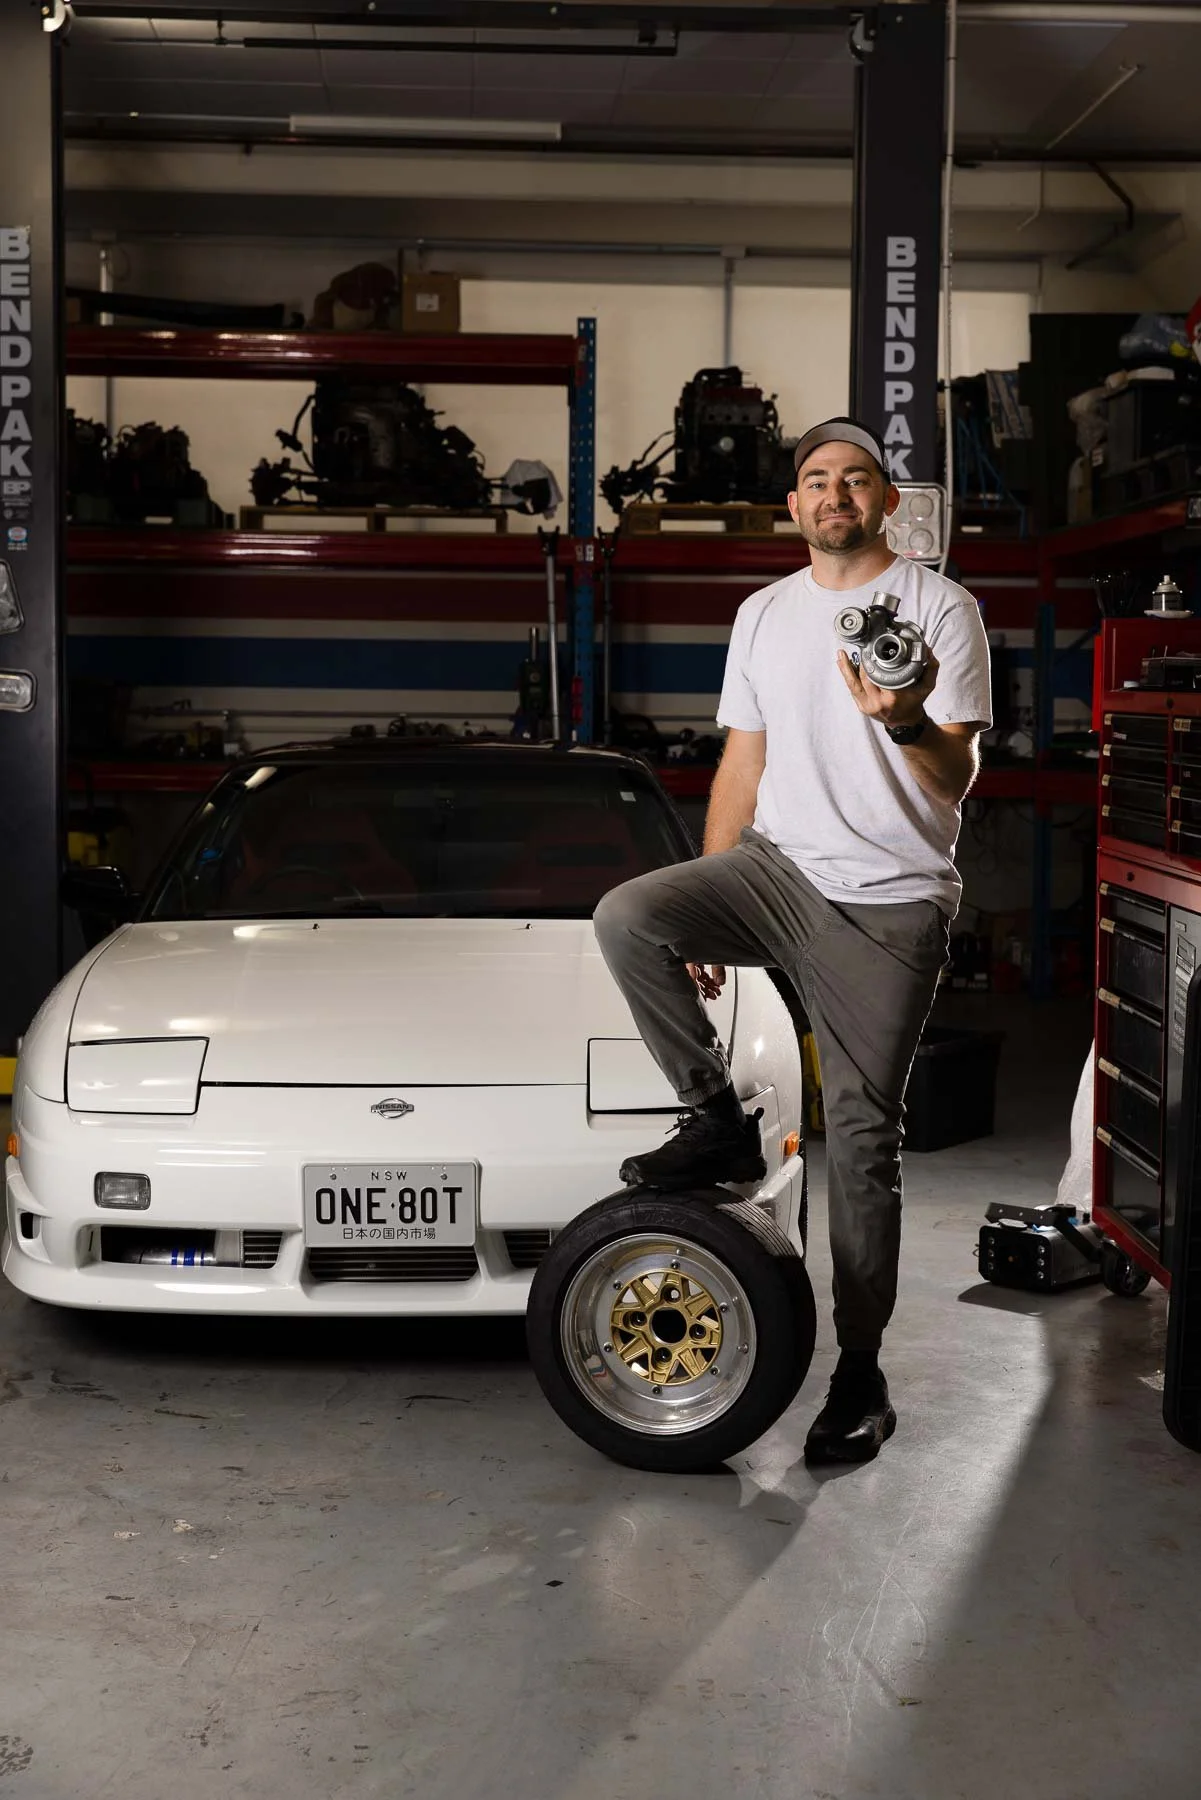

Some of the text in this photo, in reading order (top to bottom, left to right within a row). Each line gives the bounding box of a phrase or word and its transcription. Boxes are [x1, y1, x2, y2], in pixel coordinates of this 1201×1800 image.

[0, 228, 33, 477] BENDPAK
[884, 236, 917, 480] BENDPAK
[343, 1227, 436, 1240] 日本の国内市場
[371, 1171, 407, 1181] NSW
